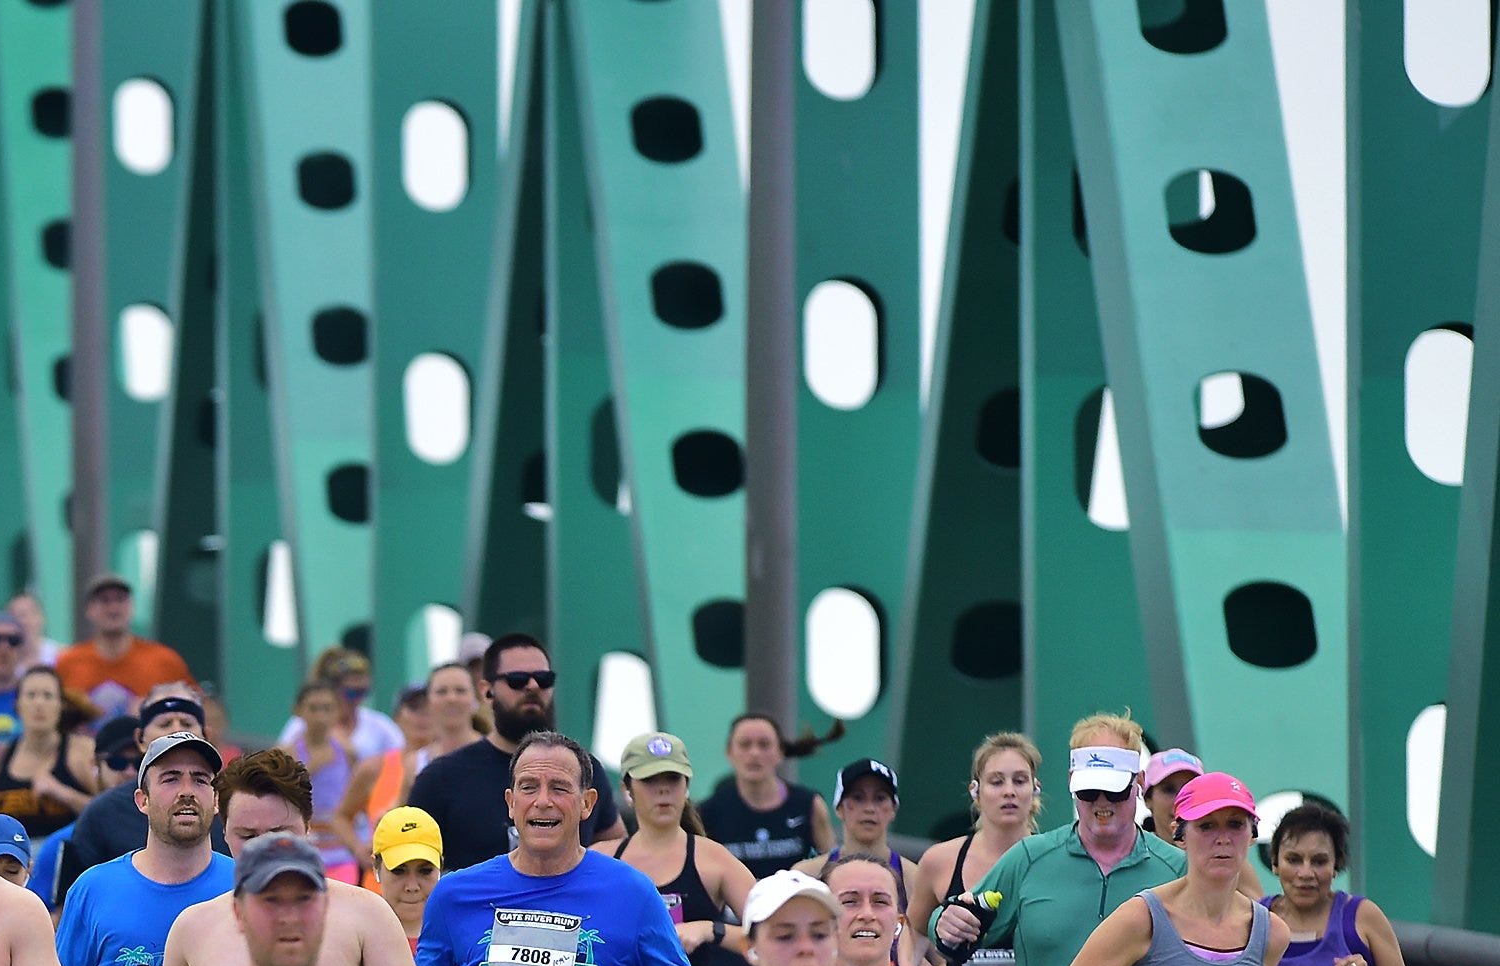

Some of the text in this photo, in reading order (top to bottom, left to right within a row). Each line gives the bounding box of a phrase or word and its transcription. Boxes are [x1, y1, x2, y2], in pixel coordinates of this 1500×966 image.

[500, 913, 523, 921] GATE
[524, 915, 553, 924] RIVER
[553, 917, 575, 927] RUN
[511, 947, 551, 965] 7808
